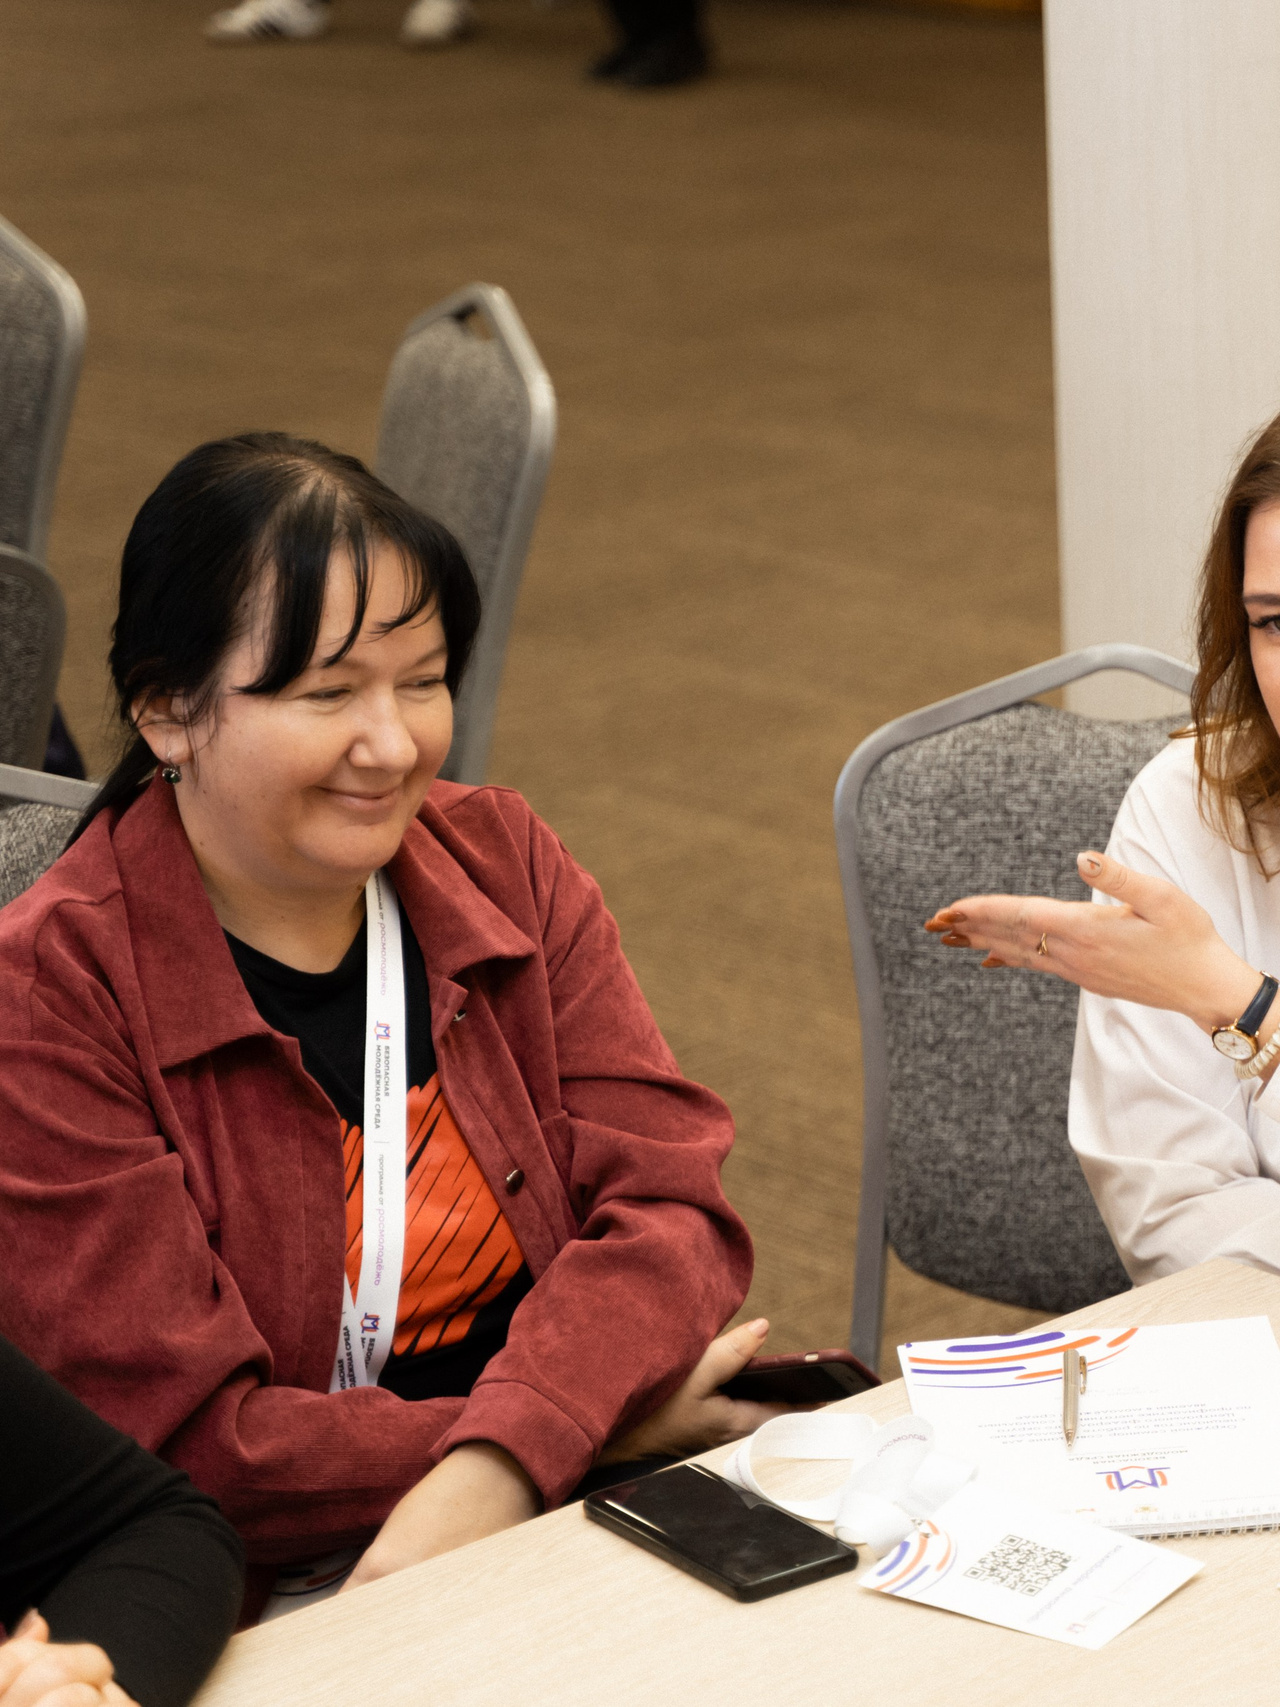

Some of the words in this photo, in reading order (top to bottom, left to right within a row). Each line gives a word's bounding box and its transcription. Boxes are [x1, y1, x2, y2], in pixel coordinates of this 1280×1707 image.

[377, 921, 386, 996] росмолодёжь
[375, 1045, 383, 1101] МОЛОДЁЖНАЯ
[374, 1103, 382, 1129] СРЕДА
[374, 1208, 385, 1287] росмолодёжь
[343, 1325, 352, 1351] СРЕДА
[1138, 1407, 1232, 1417] профилактике
[1144, 1412, 1235, 1422] Центрального
[977, 1420, 1056, 1428] социальных
[1153, 1417, 1246, 1428] специалистов
[1082, 1424, 1130, 1434] работе
[1170, 1424, 1237, 1432] Окружной
[1093, 1456, 1166, 1464] БЕЗОПАСНАЯ
